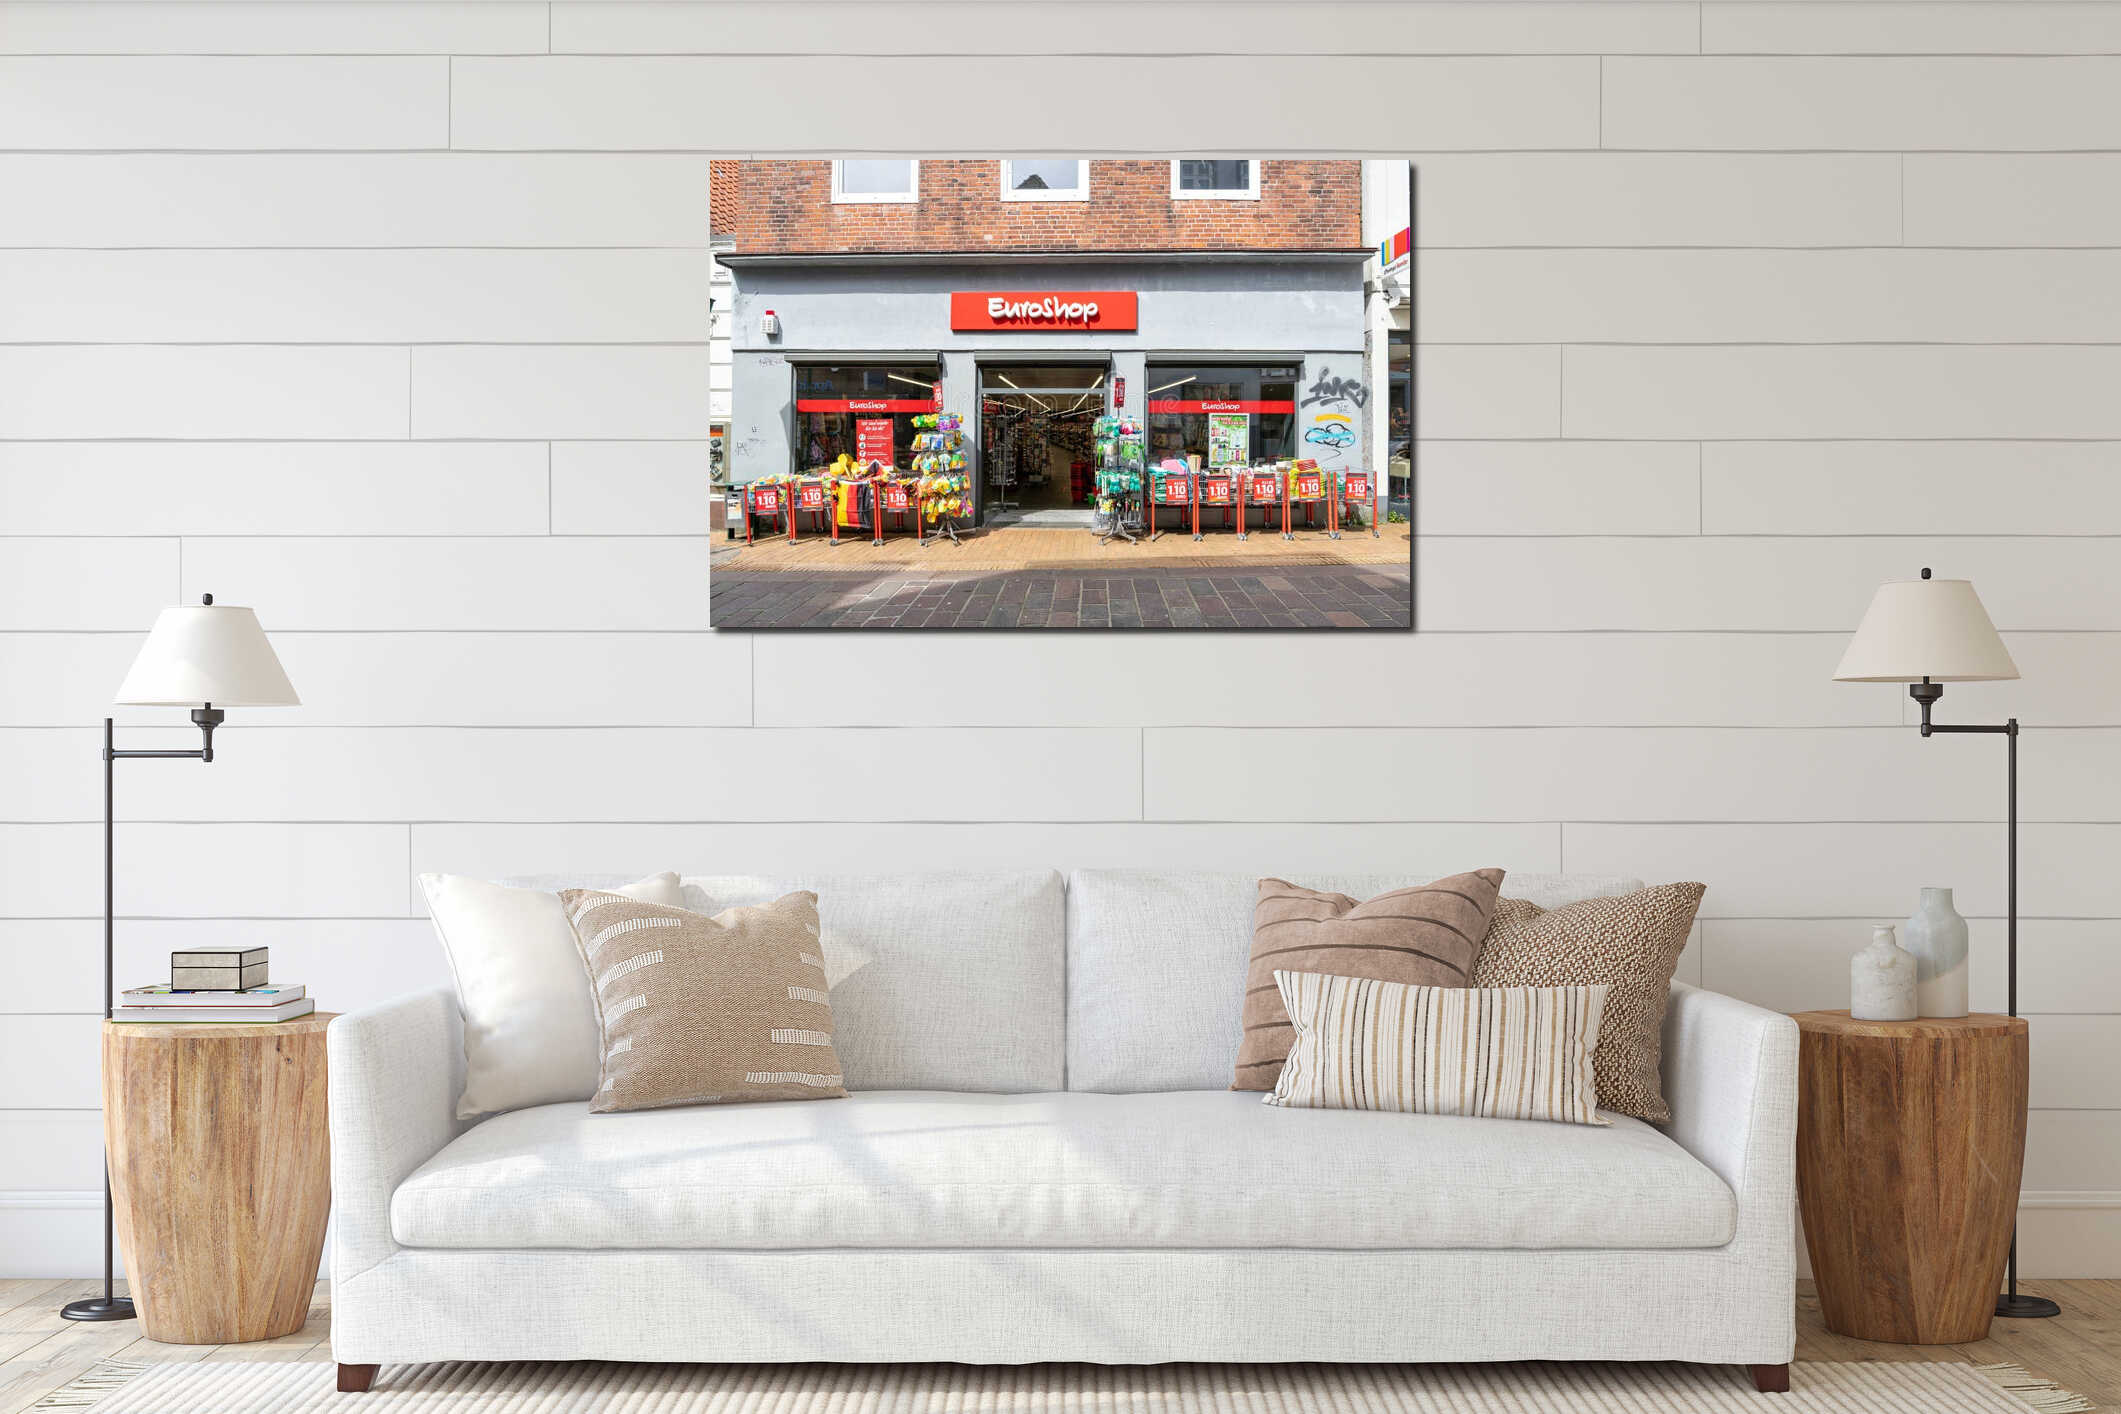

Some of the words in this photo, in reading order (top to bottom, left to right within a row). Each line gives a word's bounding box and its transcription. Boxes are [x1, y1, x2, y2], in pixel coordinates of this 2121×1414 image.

[987, 296, 1099, 323] EuroShop
[849, 400, 887, 410] EuroShop
[1201, 402, 1240, 411] EuroShop
